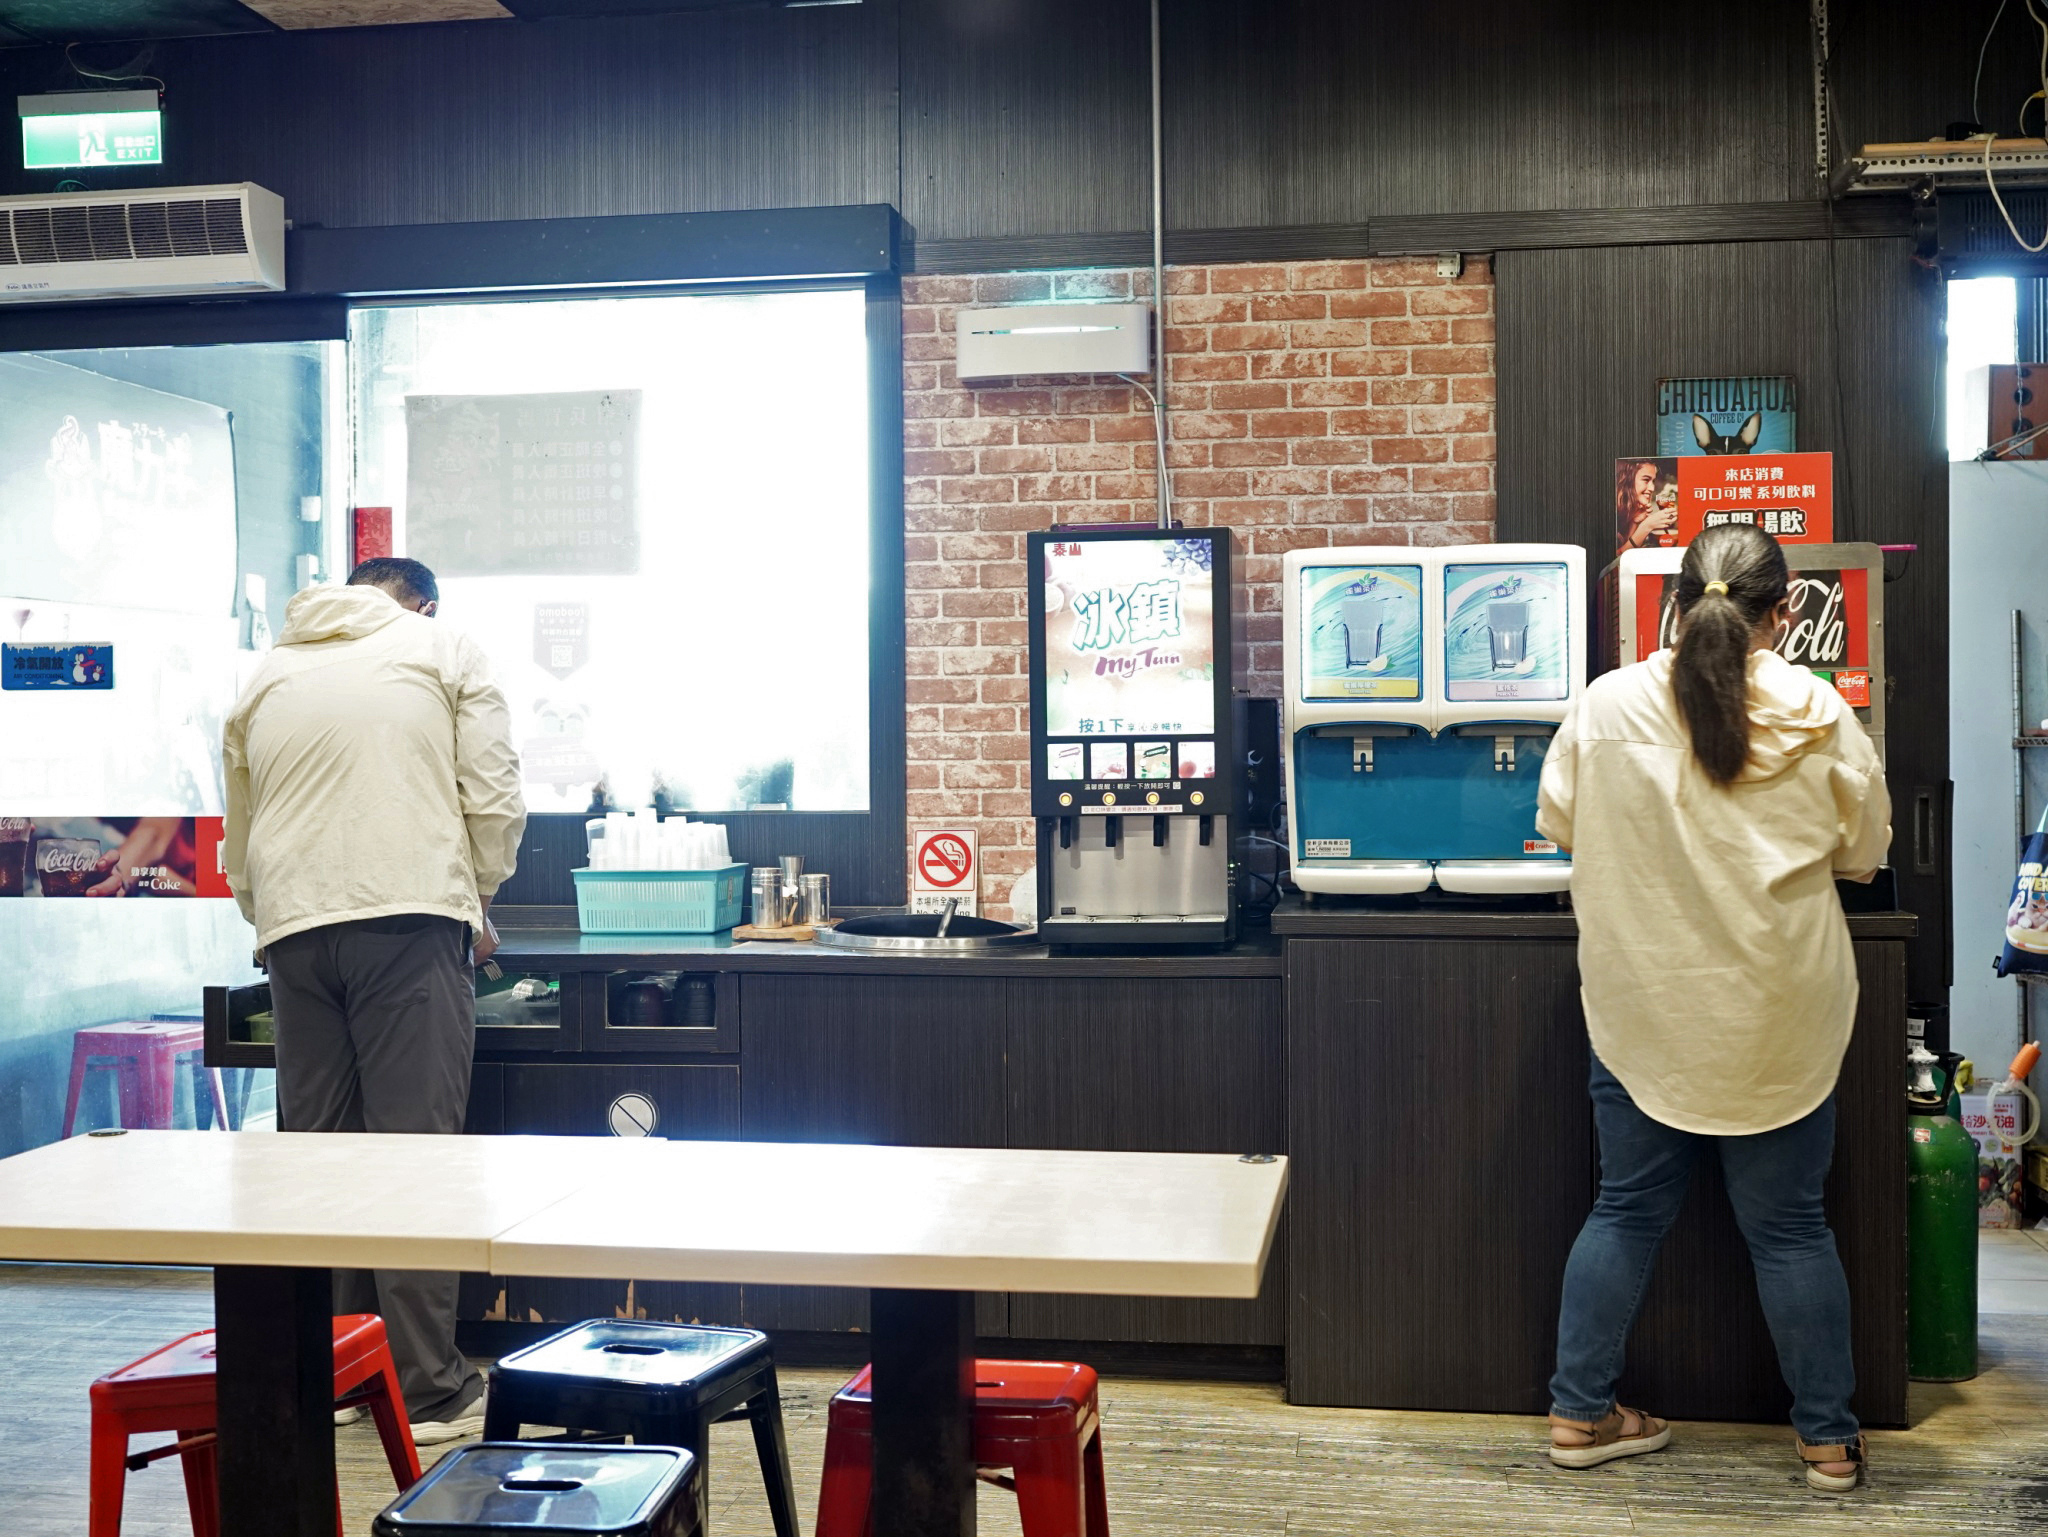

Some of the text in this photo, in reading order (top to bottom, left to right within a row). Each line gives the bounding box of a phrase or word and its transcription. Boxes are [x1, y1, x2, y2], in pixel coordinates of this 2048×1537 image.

[117, 148, 153, 158] EXIT
[1657, 377, 1797, 416] CHIHUAHUA
[1710, 413, 1736, 424] COFFEE
[132, 422, 167, 441] ステーキ
[1676, 422, 1685, 453] XICO
[1725, 466, 1784, 482] 來店消費
[1052, 543, 1082, 556] 泰山
[14, 656, 64, 670] 冷氣開放
[1095, 647, 1180, 679] My Turn
[44, 848, 99, 873] Coca-Col
[150, 878, 181, 890] Coke
[916, 896, 971, 906] 本場所全禁菸
[933, 909, 971, 917] Sing
